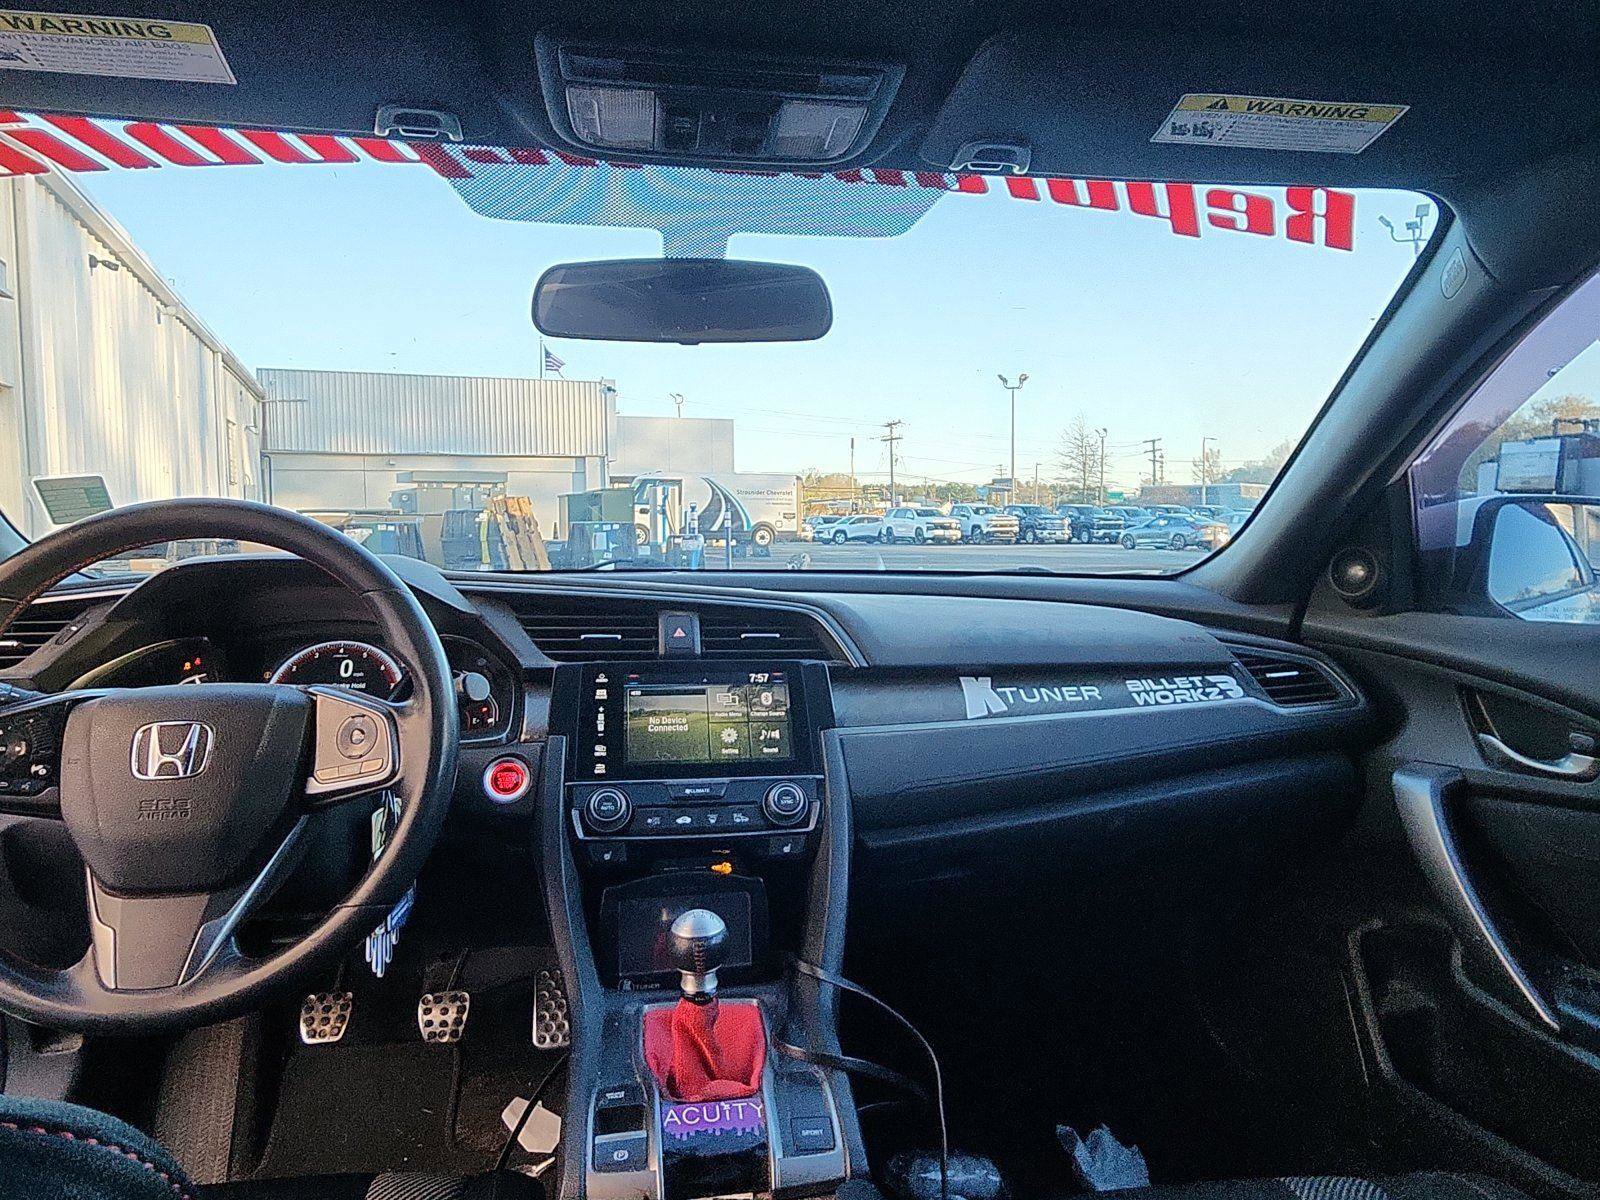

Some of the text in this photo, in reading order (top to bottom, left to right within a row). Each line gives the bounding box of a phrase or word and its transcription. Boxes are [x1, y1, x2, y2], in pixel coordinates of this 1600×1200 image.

[0, 14, 173, 39] WARNING
[1246, 100, 1370, 118] WARNING
[340, 659, 353, 678] 0
[749, 674, 769, 683] 7:57
[1125, 676, 1203, 691] BILLET
[648, 724, 689, 732] Connected
[662, 717, 686, 725] Device
[664, 1101, 763, 1126] ACUITY
